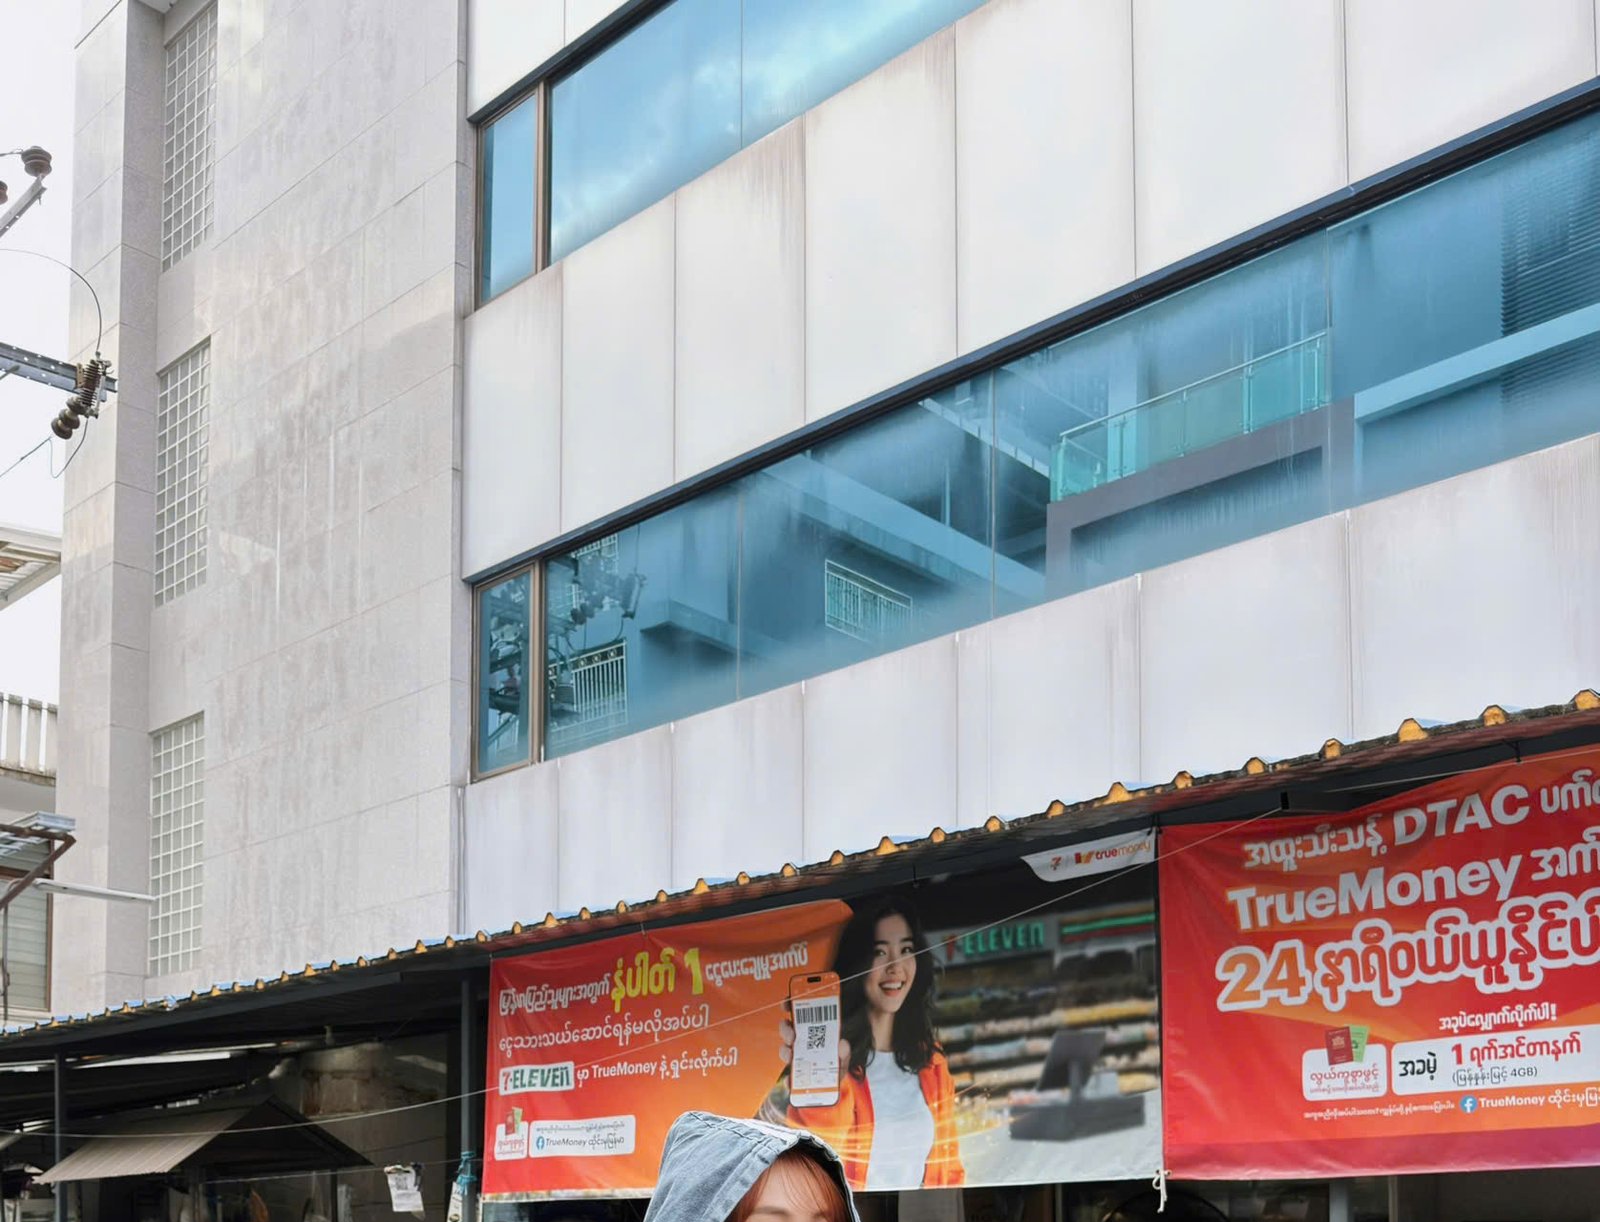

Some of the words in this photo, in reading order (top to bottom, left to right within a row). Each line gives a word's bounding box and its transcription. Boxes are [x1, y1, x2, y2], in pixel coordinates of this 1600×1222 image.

[1393, 785, 1530, 846] DTAC
[1227, 853, 1523, 930] TrueMoney
[684, 947, 704, 995] 1
[1219, 942, 1307, 1007] 24
[1399, 1051, 1437, 1080] အခမဲ့
[1451, 1043, 1463, 1065] 1
[592, 1060, 657, 1078] TrueMoney
[1510, 1066, 1538, 1078] 4GB)
[1480, 1092, 1545, 1109] TrueMoney
[546, 1137, 586, 1147] TrueMoney
